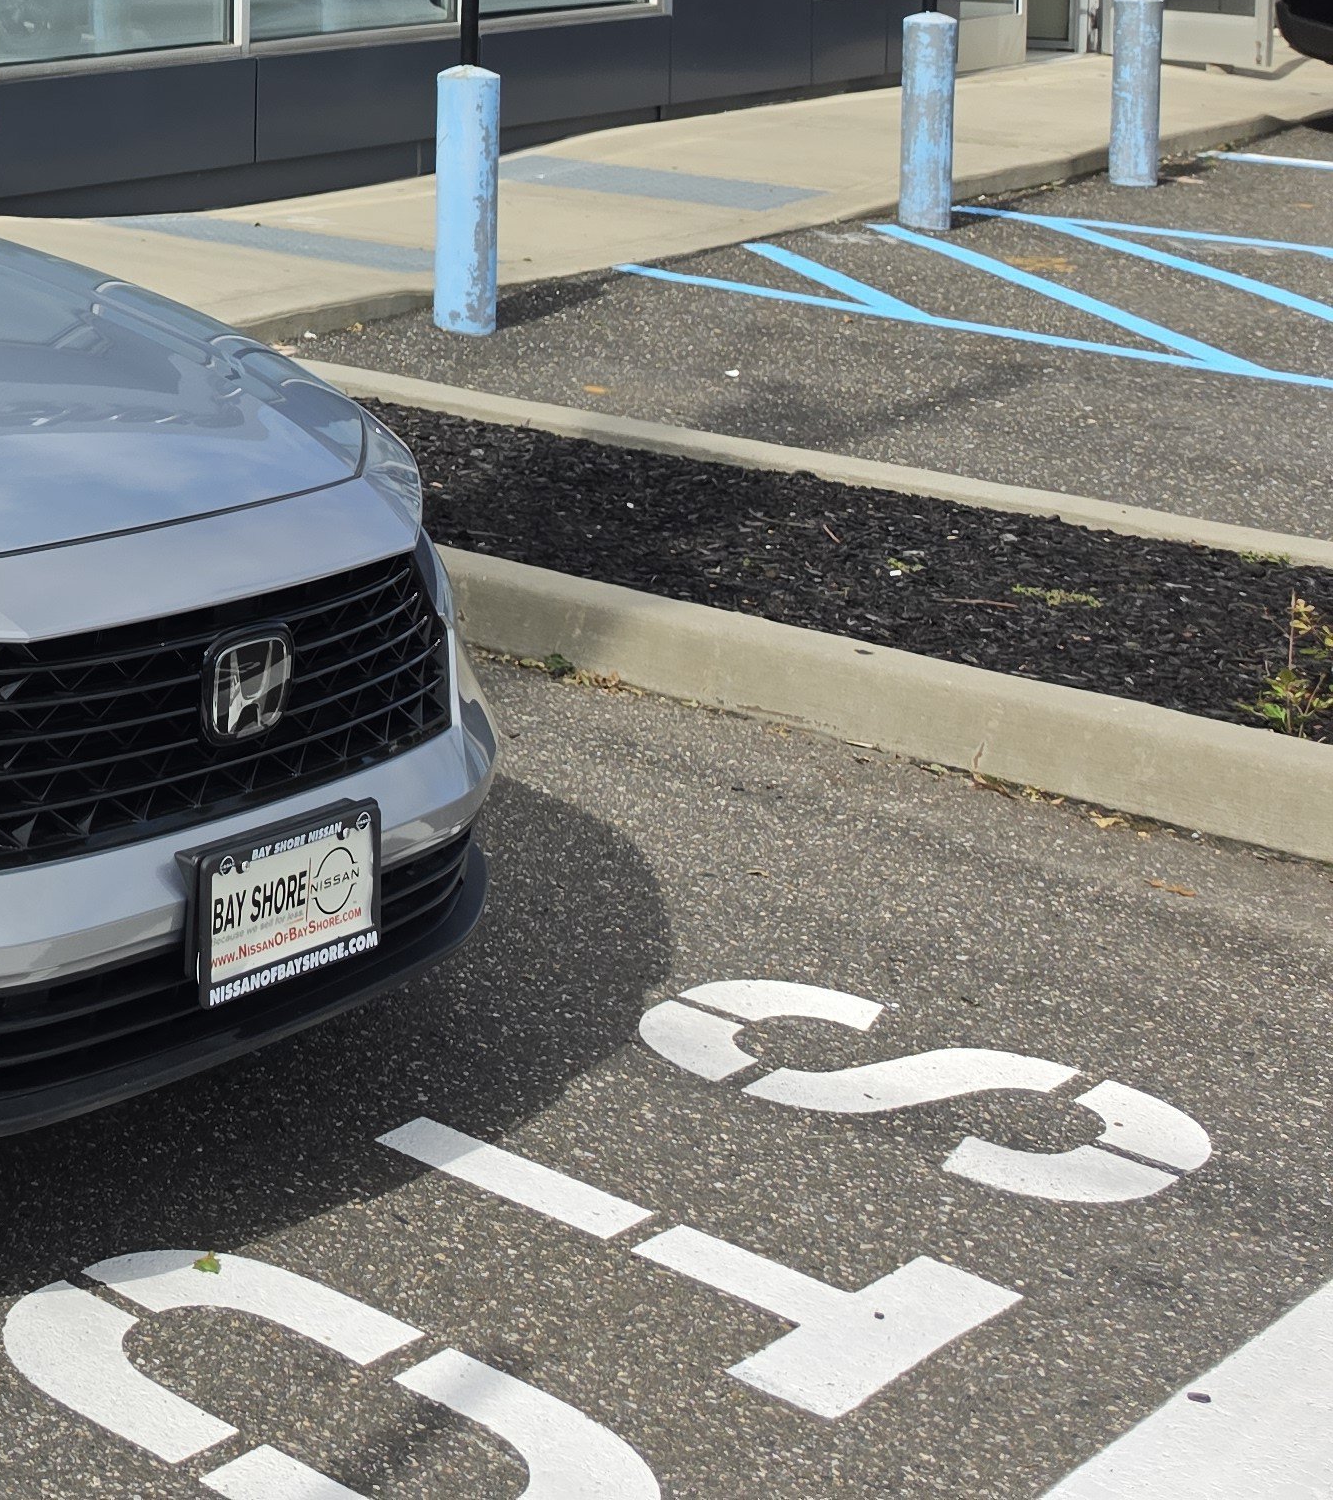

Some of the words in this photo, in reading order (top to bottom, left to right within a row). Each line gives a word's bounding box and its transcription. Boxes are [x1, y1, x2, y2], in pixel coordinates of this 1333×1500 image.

[251, 845, 272, 861] BAY
[273, 834, 307, 855] SHORE
[307, 821, 343, 843] NISSAN
[213, 889, 247, 936] BAY
[250, 870, 308, 923] SHORE
[310, 866, 360, 894] NISSAN
[209, 930, 378, 1007] NISSANOFBAYSHORE.COM
